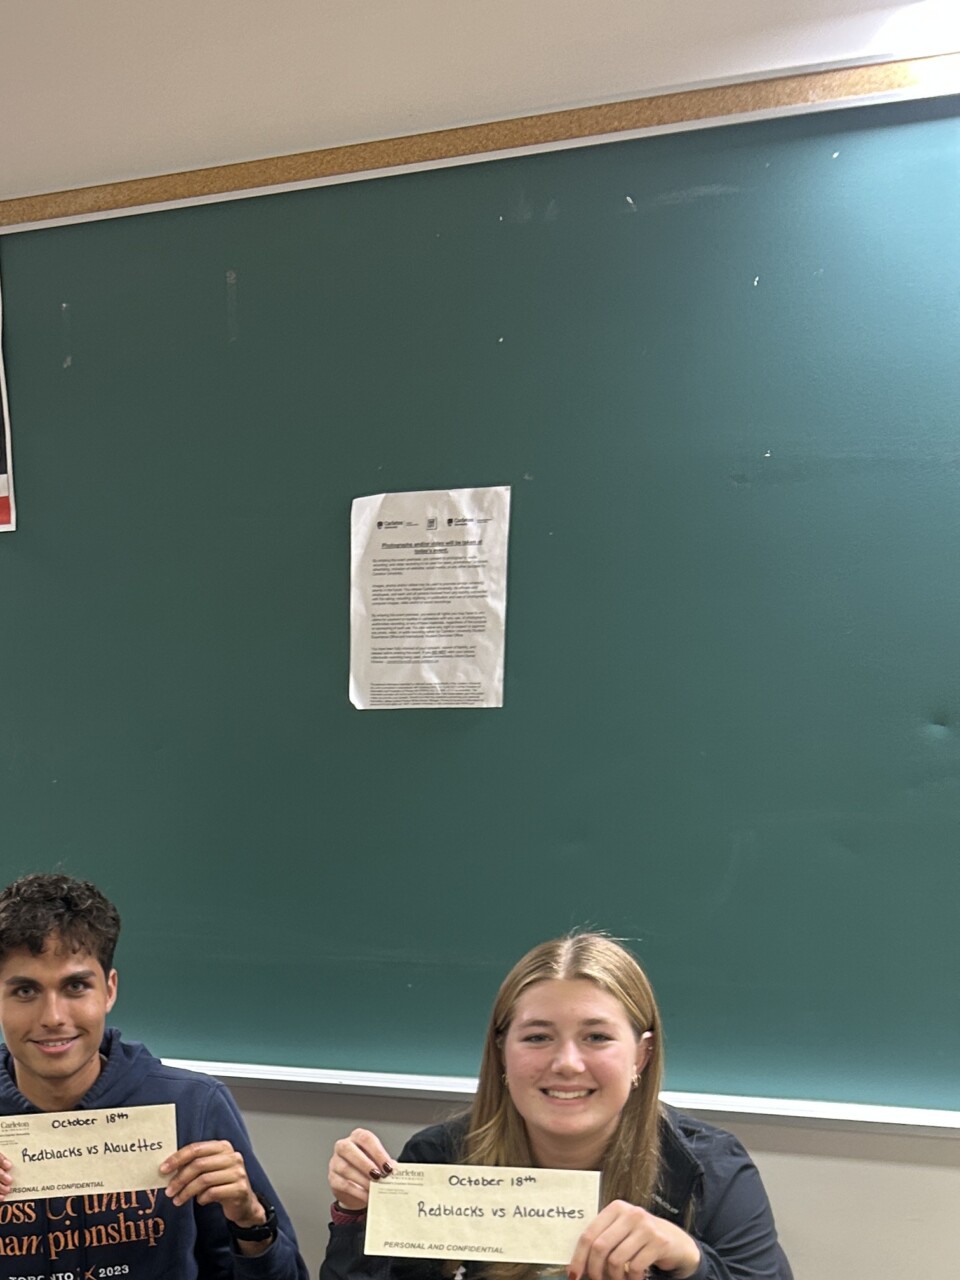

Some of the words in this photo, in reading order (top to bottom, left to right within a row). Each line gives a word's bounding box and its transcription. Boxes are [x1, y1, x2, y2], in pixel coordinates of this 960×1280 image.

[1, 1121, 29, 1129] Carleton
[51, 1118, 97, 1129] October
[105, 1112, 129, 1124] 18th
[21, 1147, 83, 1163] Redblacks
[86, 1145, 99, 1155] vs
[103, 1138, 163, 1155] Alouettes
[8, 1185, 39, 1194] ERSONAL
[56, 1181, 105, 1190] CONFIDENTIAL
[449, 1175, 504, 1187] October
[511, 1176, 536, 1187] 18th
[417, 1200, 485, 1218] Redblacks
[491, 1207, 506, 1218] vs
[513, 1205, 585, 1219] Alouettes
[383, 1240, 425, 1250] PERSONAL
[427, 1242, 444, 1251] AND
[446, 1244, 504, 1254] CONFIDENTIAL
[98, 1264, 130, 1278] 2023
